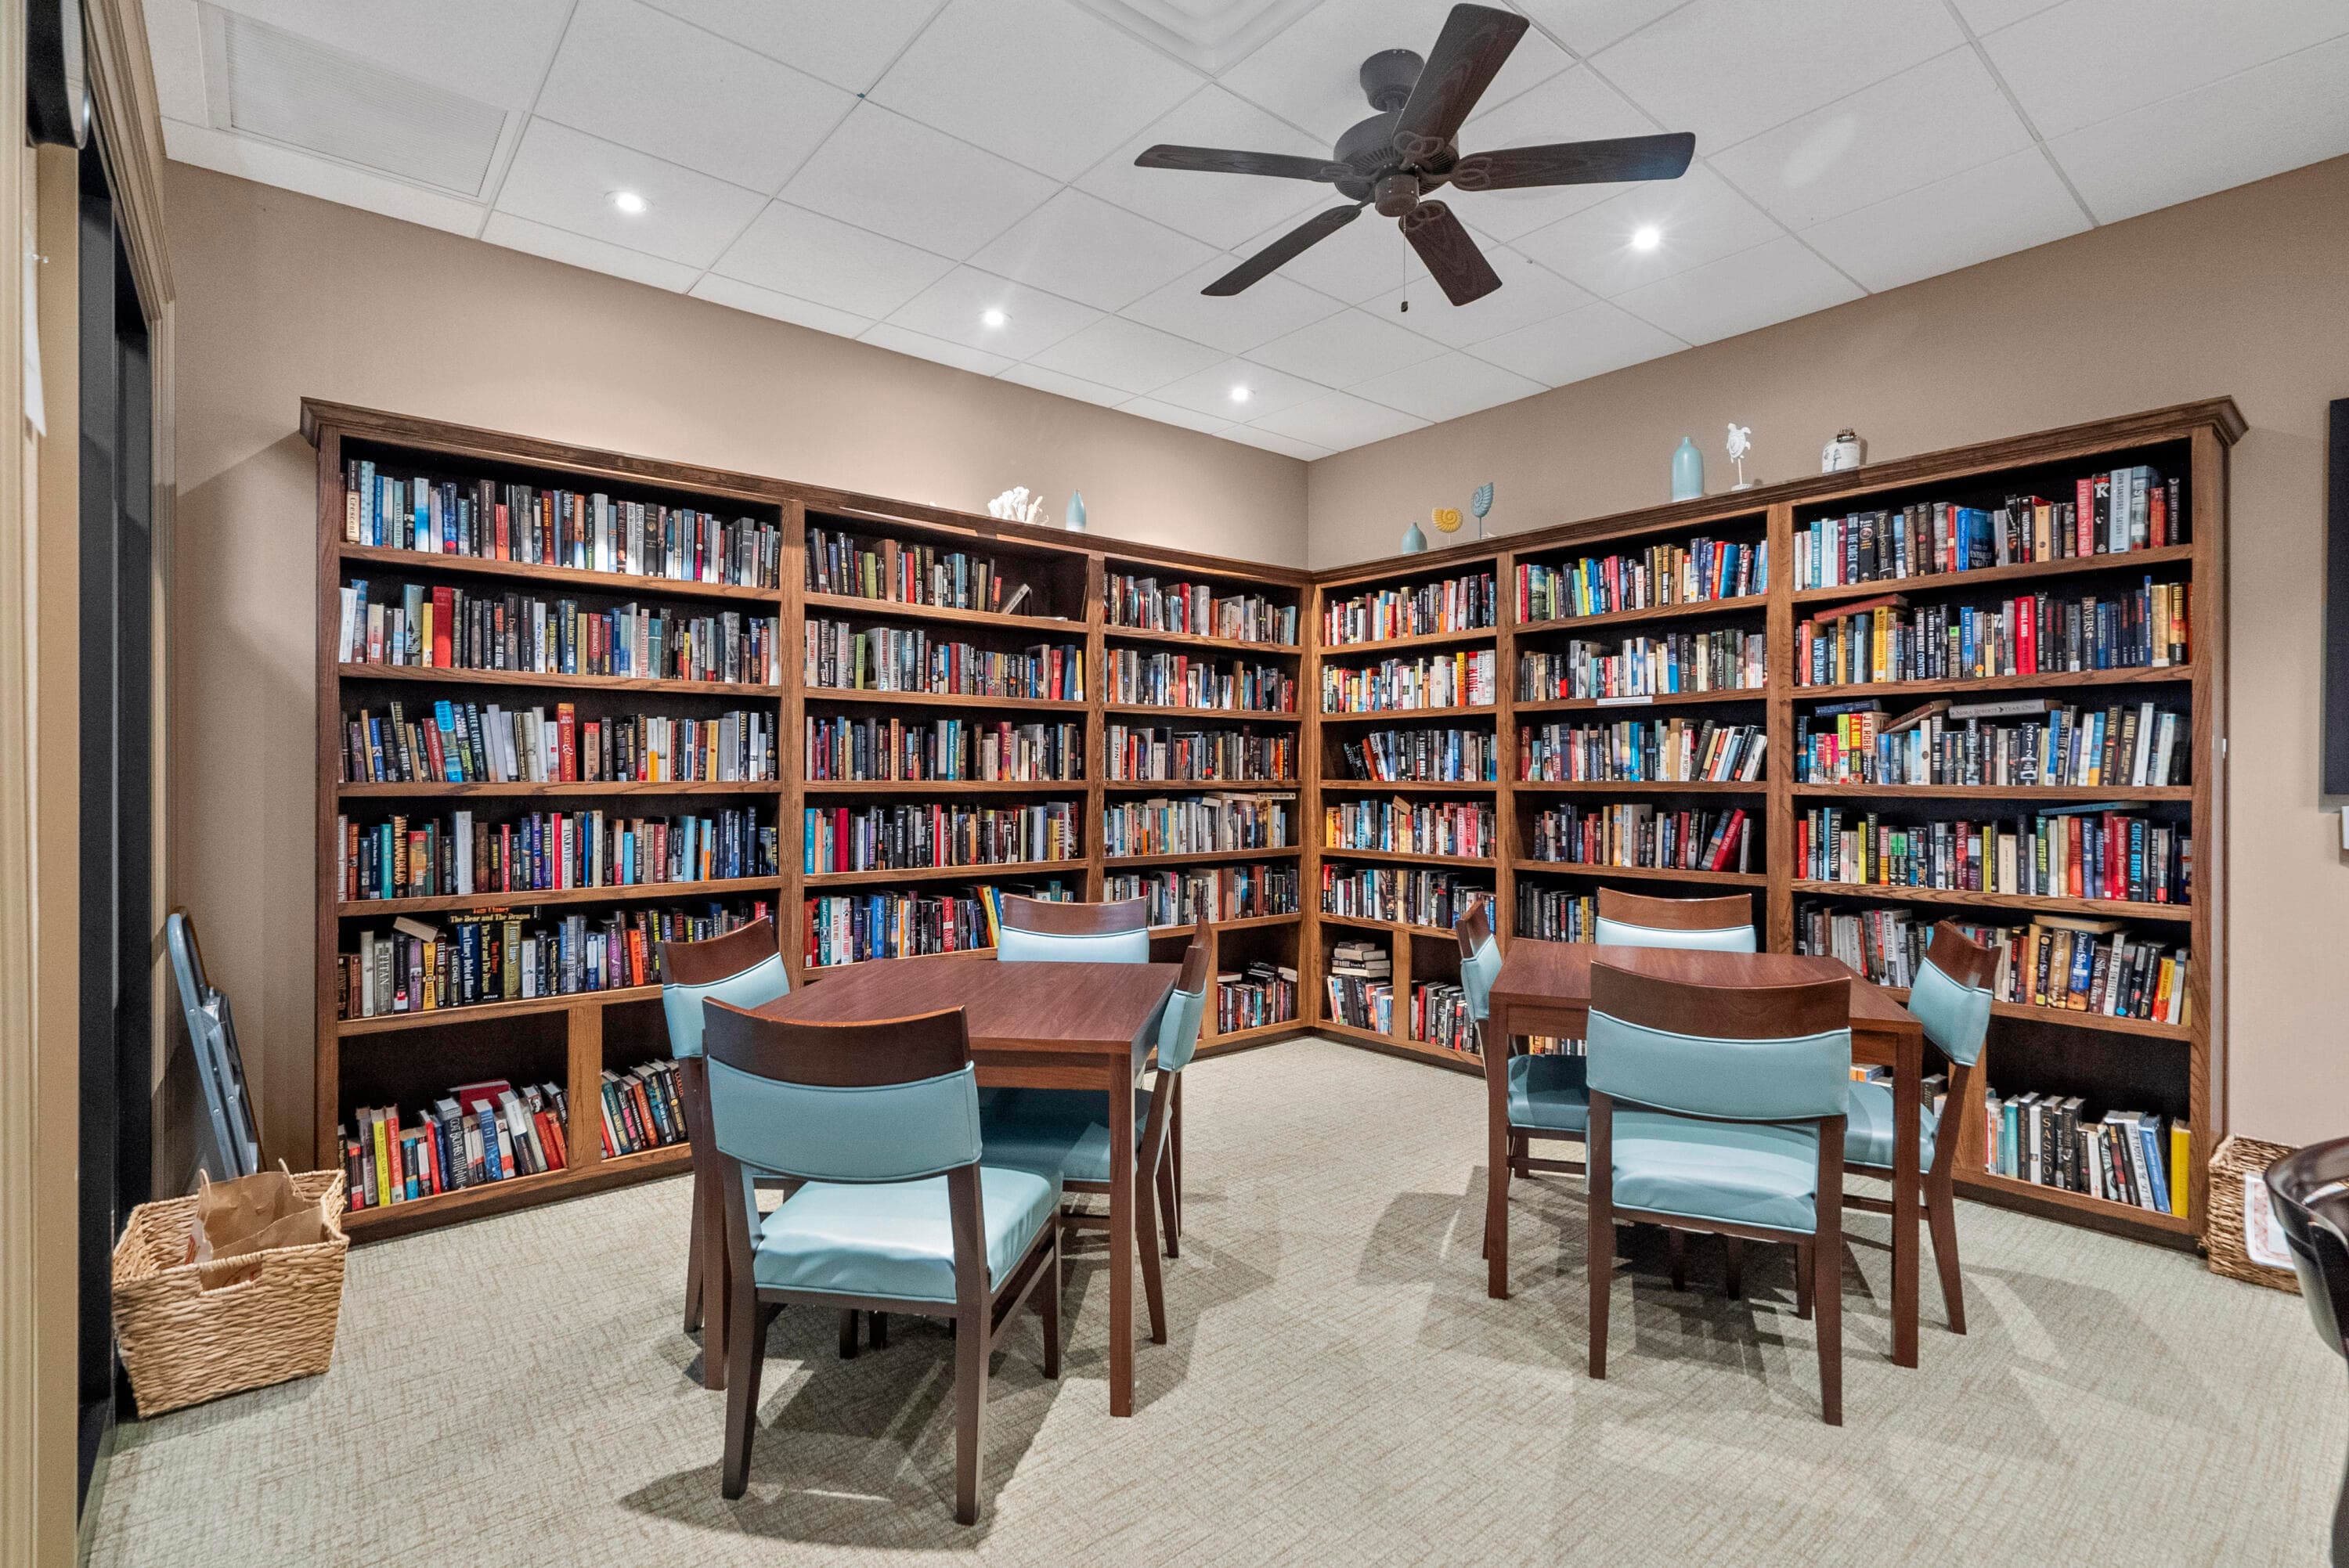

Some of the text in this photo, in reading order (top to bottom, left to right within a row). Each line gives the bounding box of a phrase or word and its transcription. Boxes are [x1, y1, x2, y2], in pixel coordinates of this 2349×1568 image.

[2077, 479, 2089, 534] Fortunate Son
[1848, 533, 1856, 561] THE CODEX
[506, 617, 515, 632] Days
[2084, 600, 2093, 631] RIVERS
[1813, 639, 1824, 683] AYN RAND
[468, 705, 481, 752] OLIVER LOVING
[2107, 708, 2117, 735] KAREN ROSE
[2125, 716, 2135, 737] ANN RULE
[1851, 731, 1860, 746] ROBB
[563, 829, 572, 861] TAKEOVER
[2131, 823, 2141, 881] CHUCK BERRY
[462, 926, 471, 938] Tom
[506, 925, 519, 964] Tom Clancy
[461, 939, 471, 957] Clancy
[2076, 932, 2087, 968] Daniel Silva
[379, 953, 388, 985] TITAN
[464, 959, 472, 971] Debt
[2095, 959, 2104, 976] Silva
[464, 979, 472, 998] Honor
[481, 972, 489, 992] Dragon
